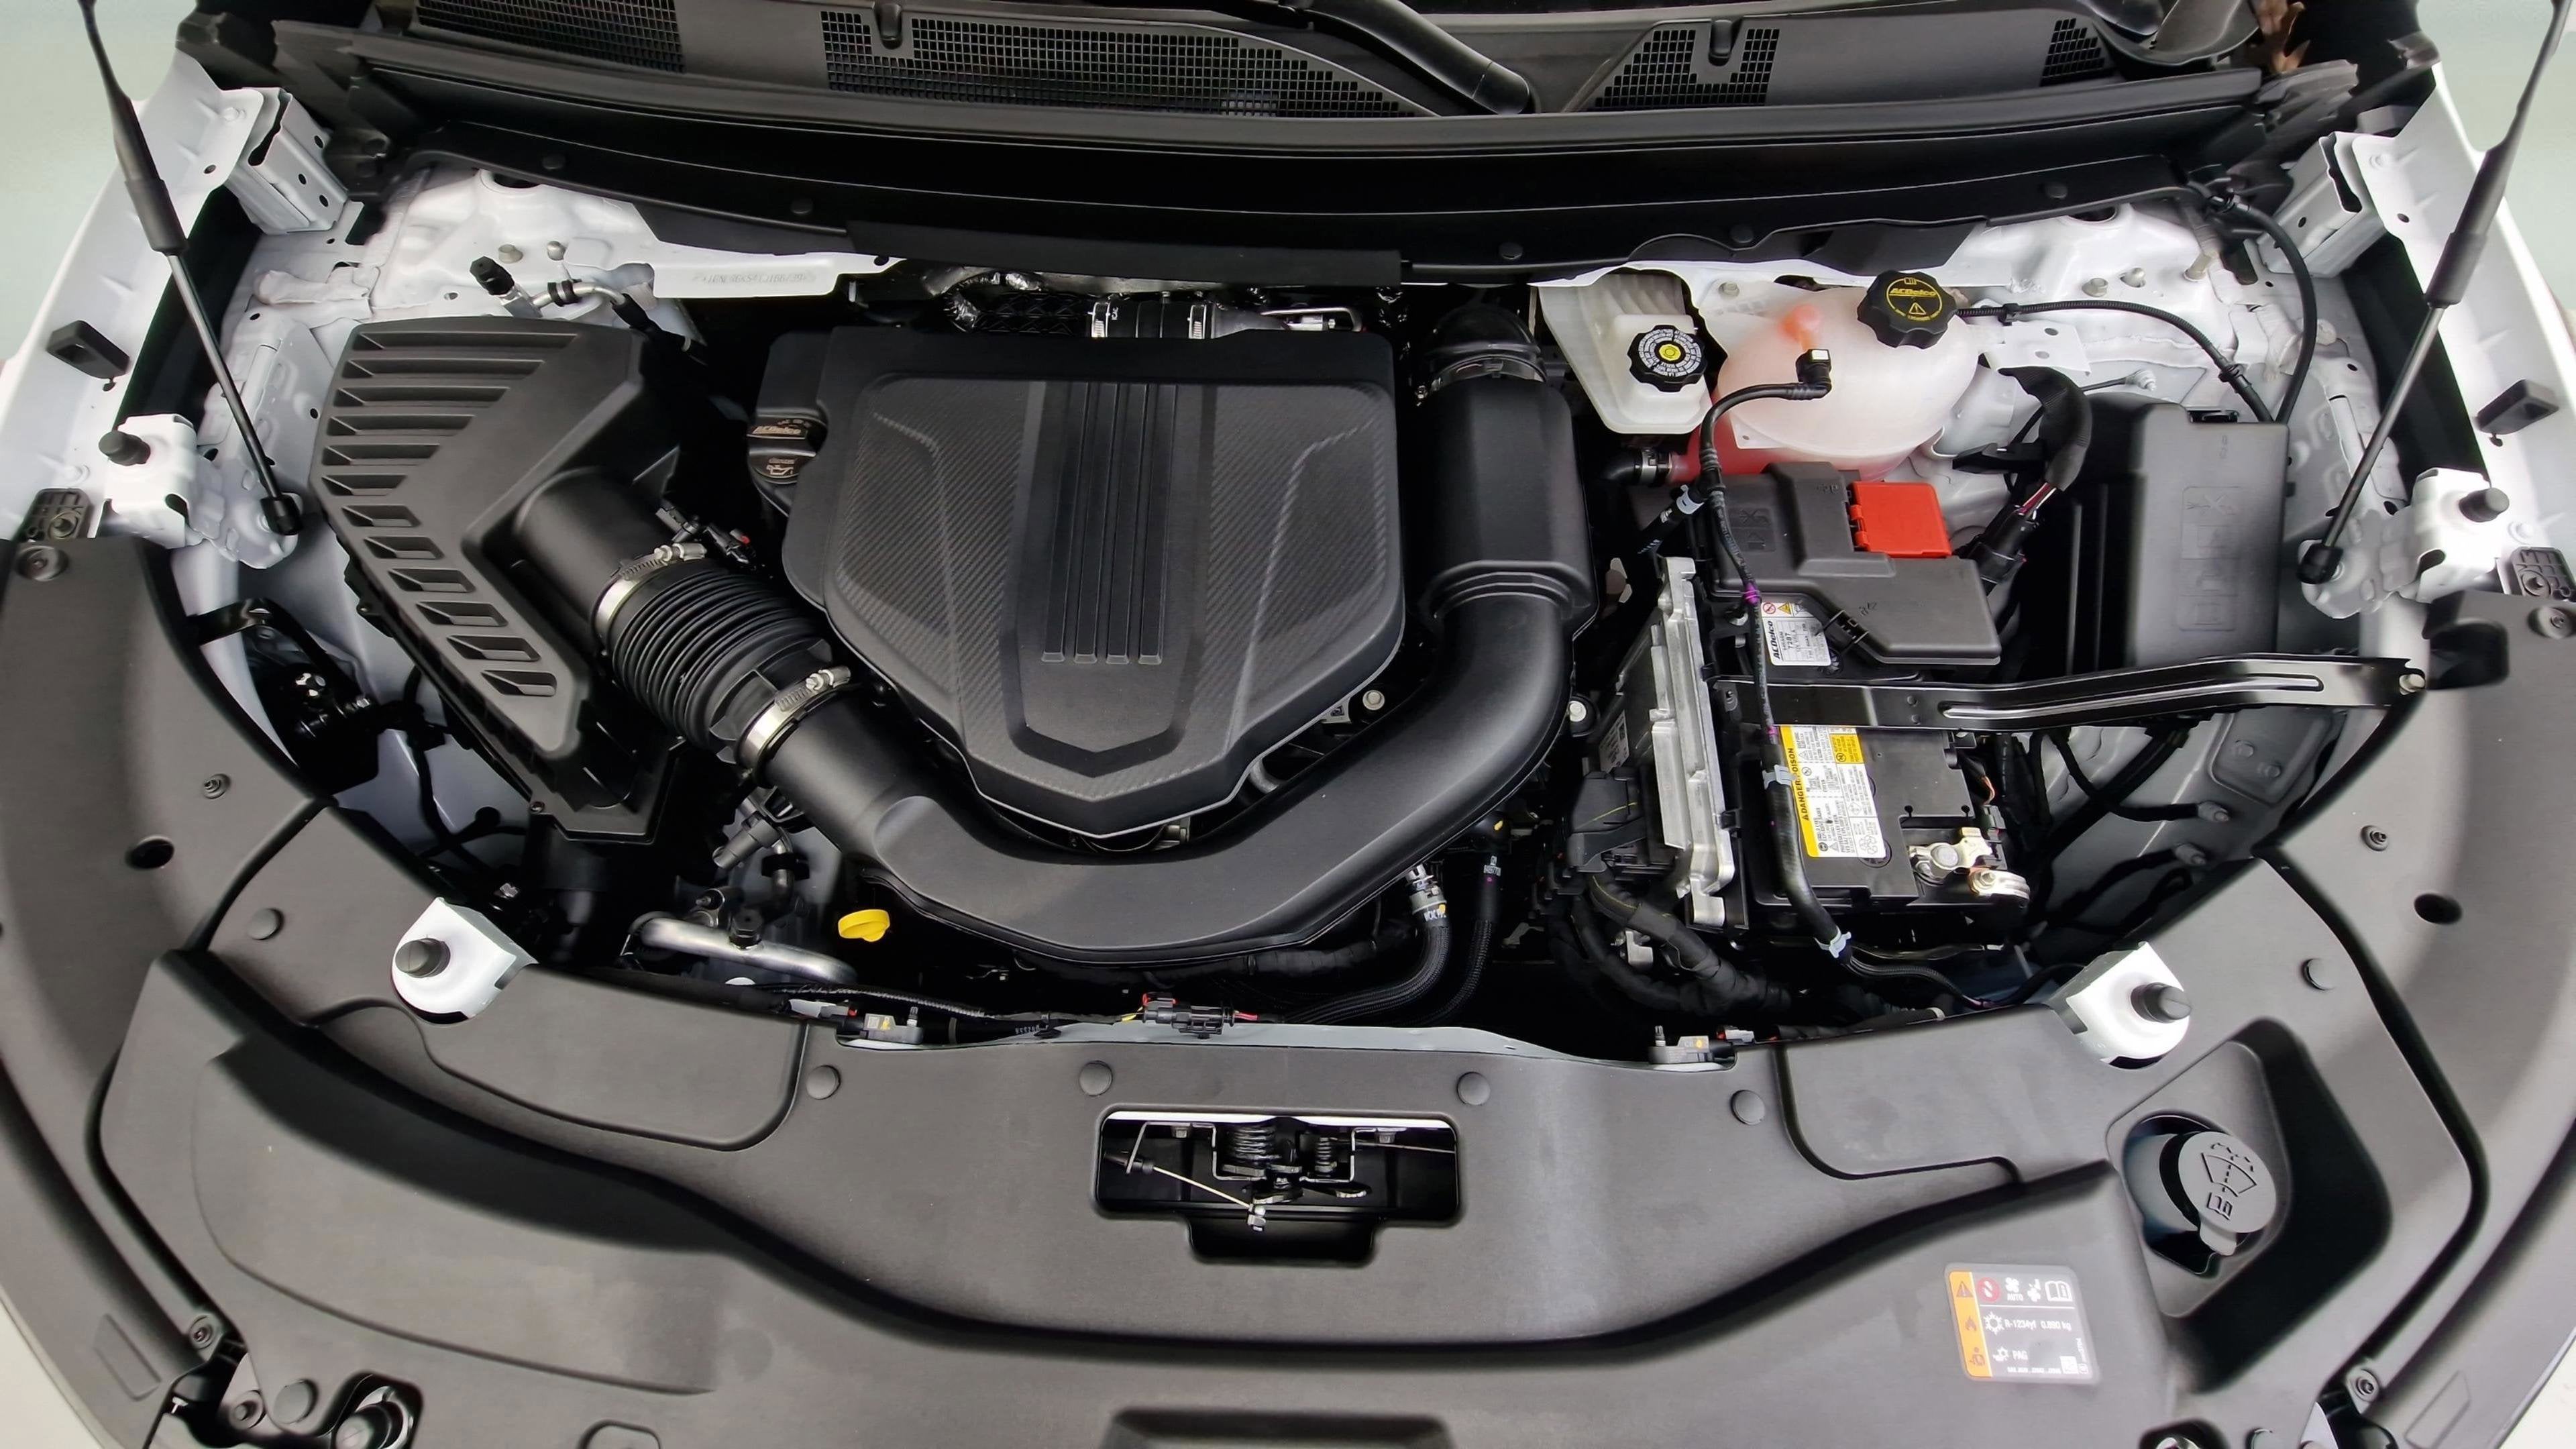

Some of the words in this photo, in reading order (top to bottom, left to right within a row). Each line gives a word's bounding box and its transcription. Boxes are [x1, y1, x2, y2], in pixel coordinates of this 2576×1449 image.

[1890, 288, 1937, 297] ACDelco
[752, 425, 802, 435] ACDelco
[1768, 621, 1780, 659] ACDelco
[2007, 1293, 2024, 1301] AUTO
[2012, 1350, 2029, 1360] PAG
